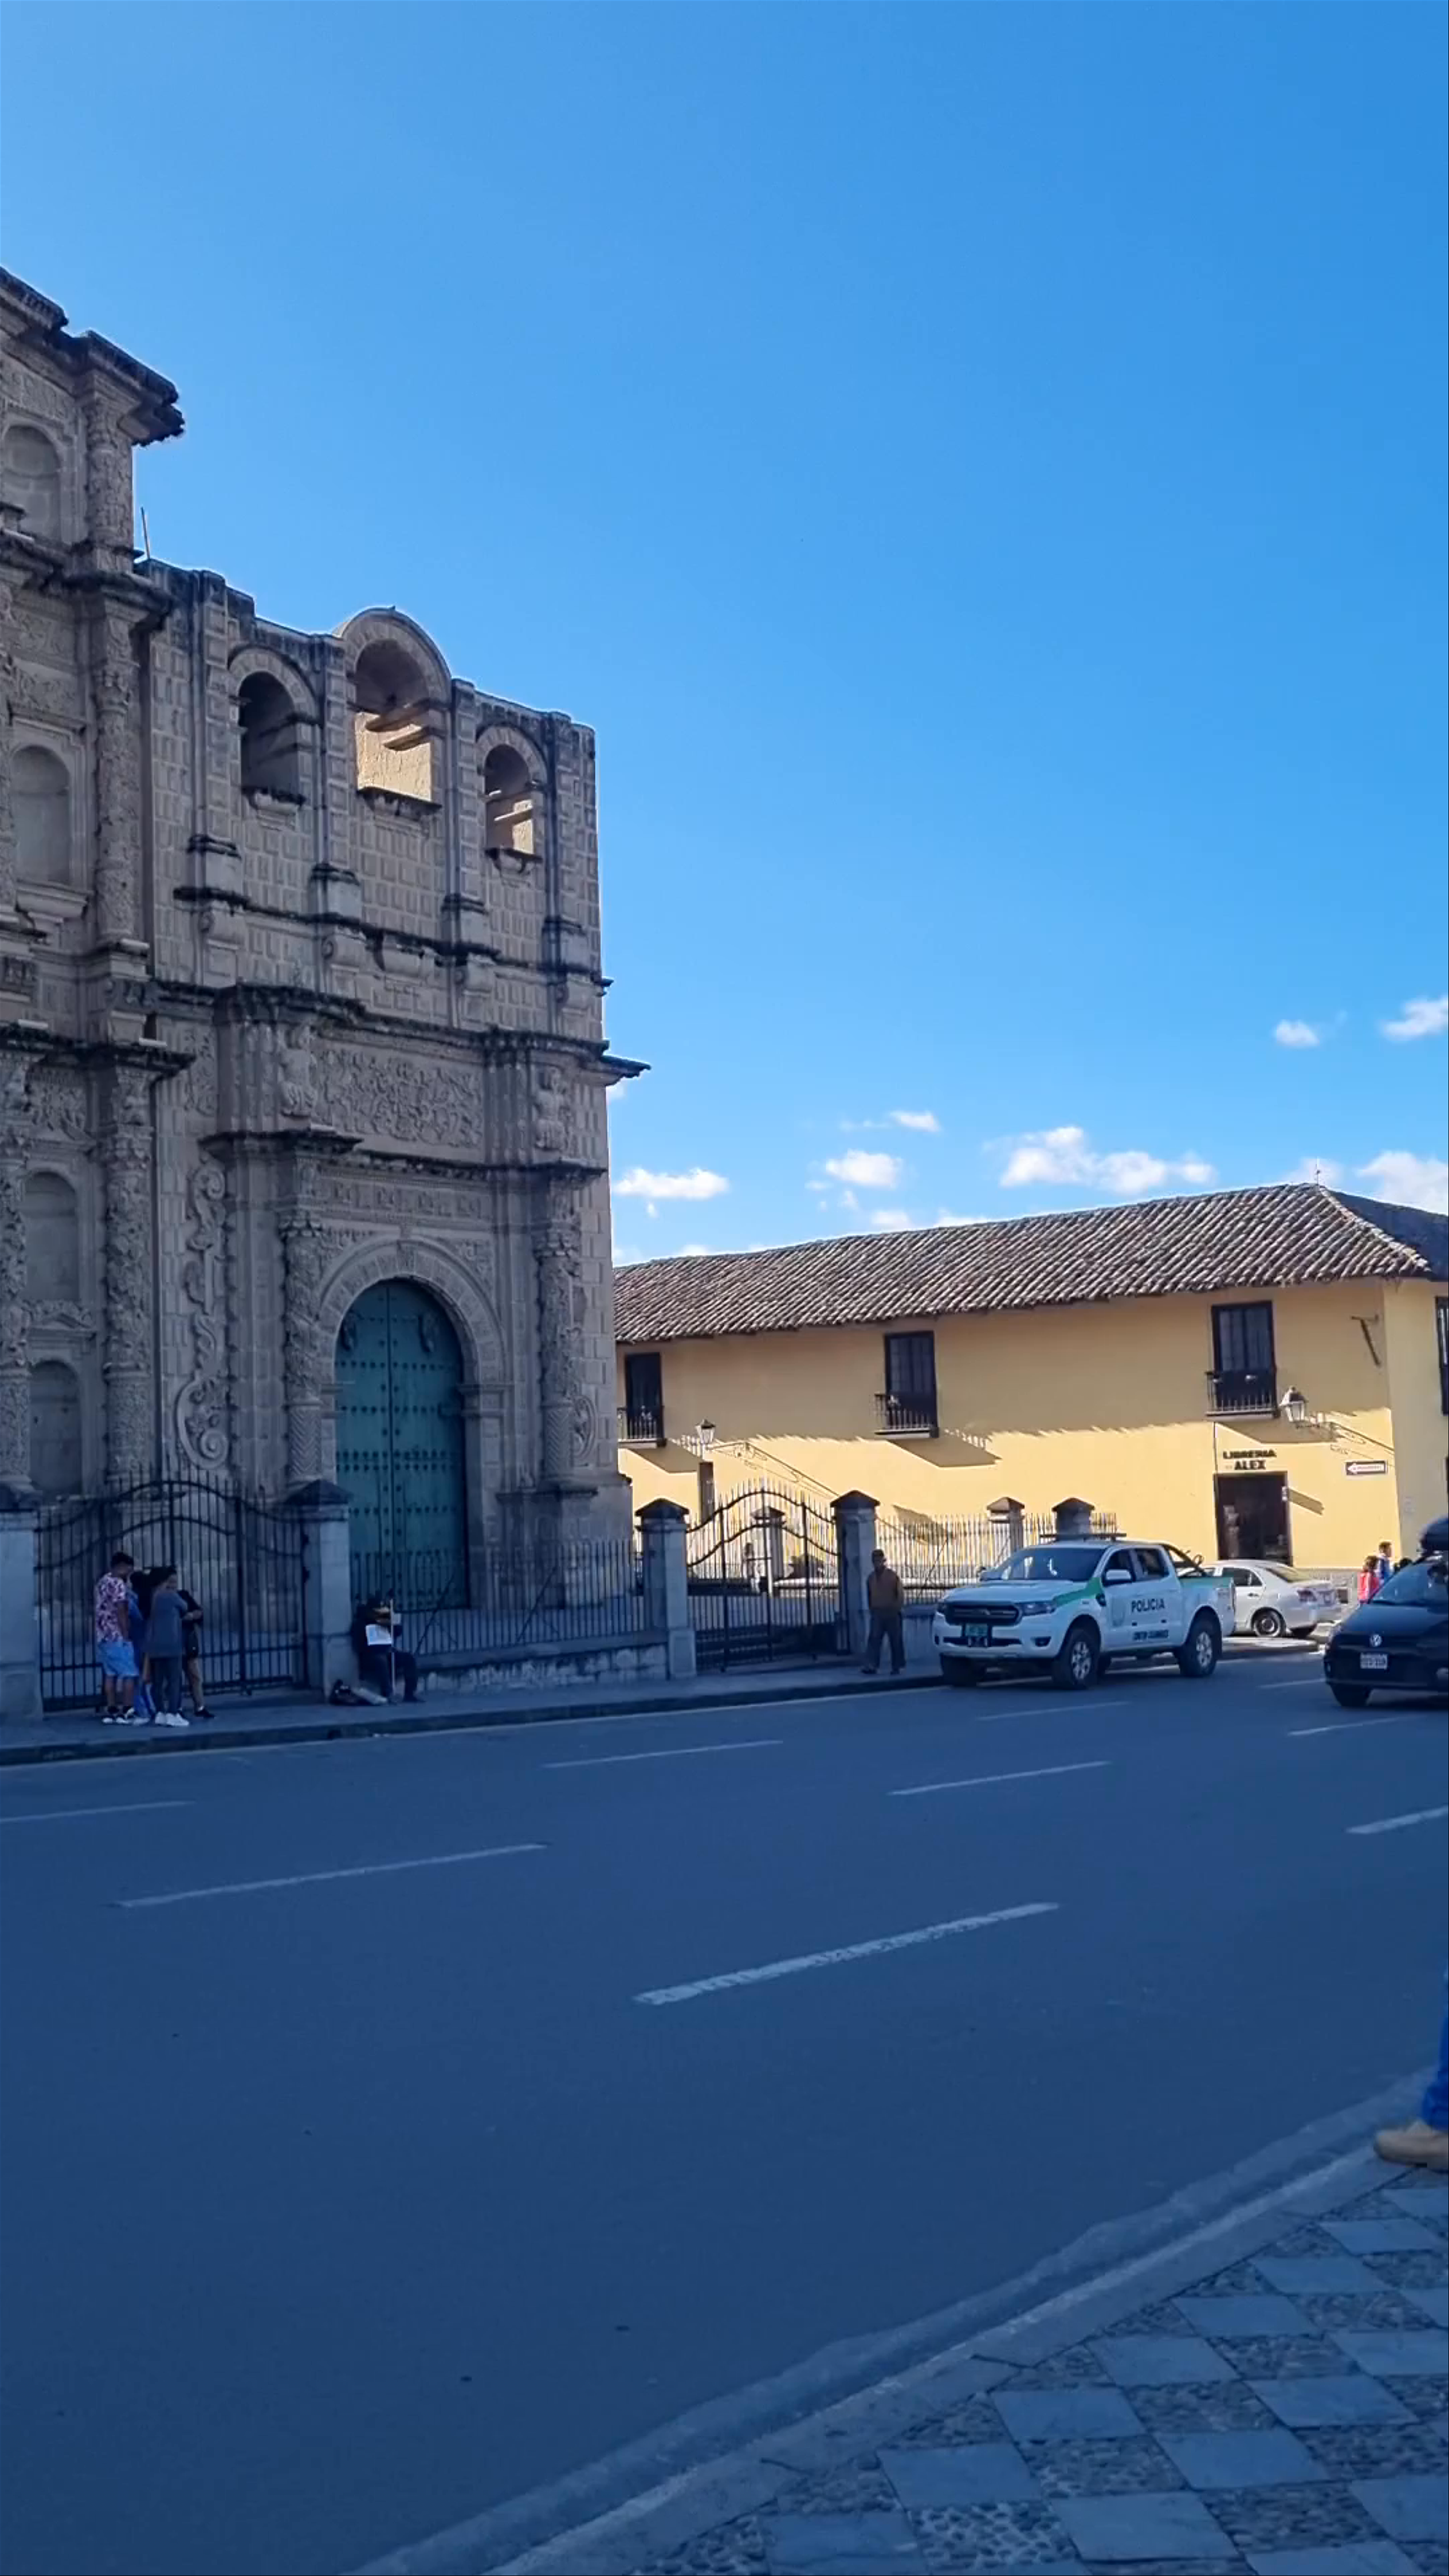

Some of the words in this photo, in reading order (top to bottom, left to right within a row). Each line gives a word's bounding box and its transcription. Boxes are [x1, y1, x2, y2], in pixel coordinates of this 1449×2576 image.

[1223, 1449, 1277, 1459] LIBRERIA
[1234, 1460, 1266, 1470] ALEX
[1131, 1599, 1165, 1612] POLICIA
